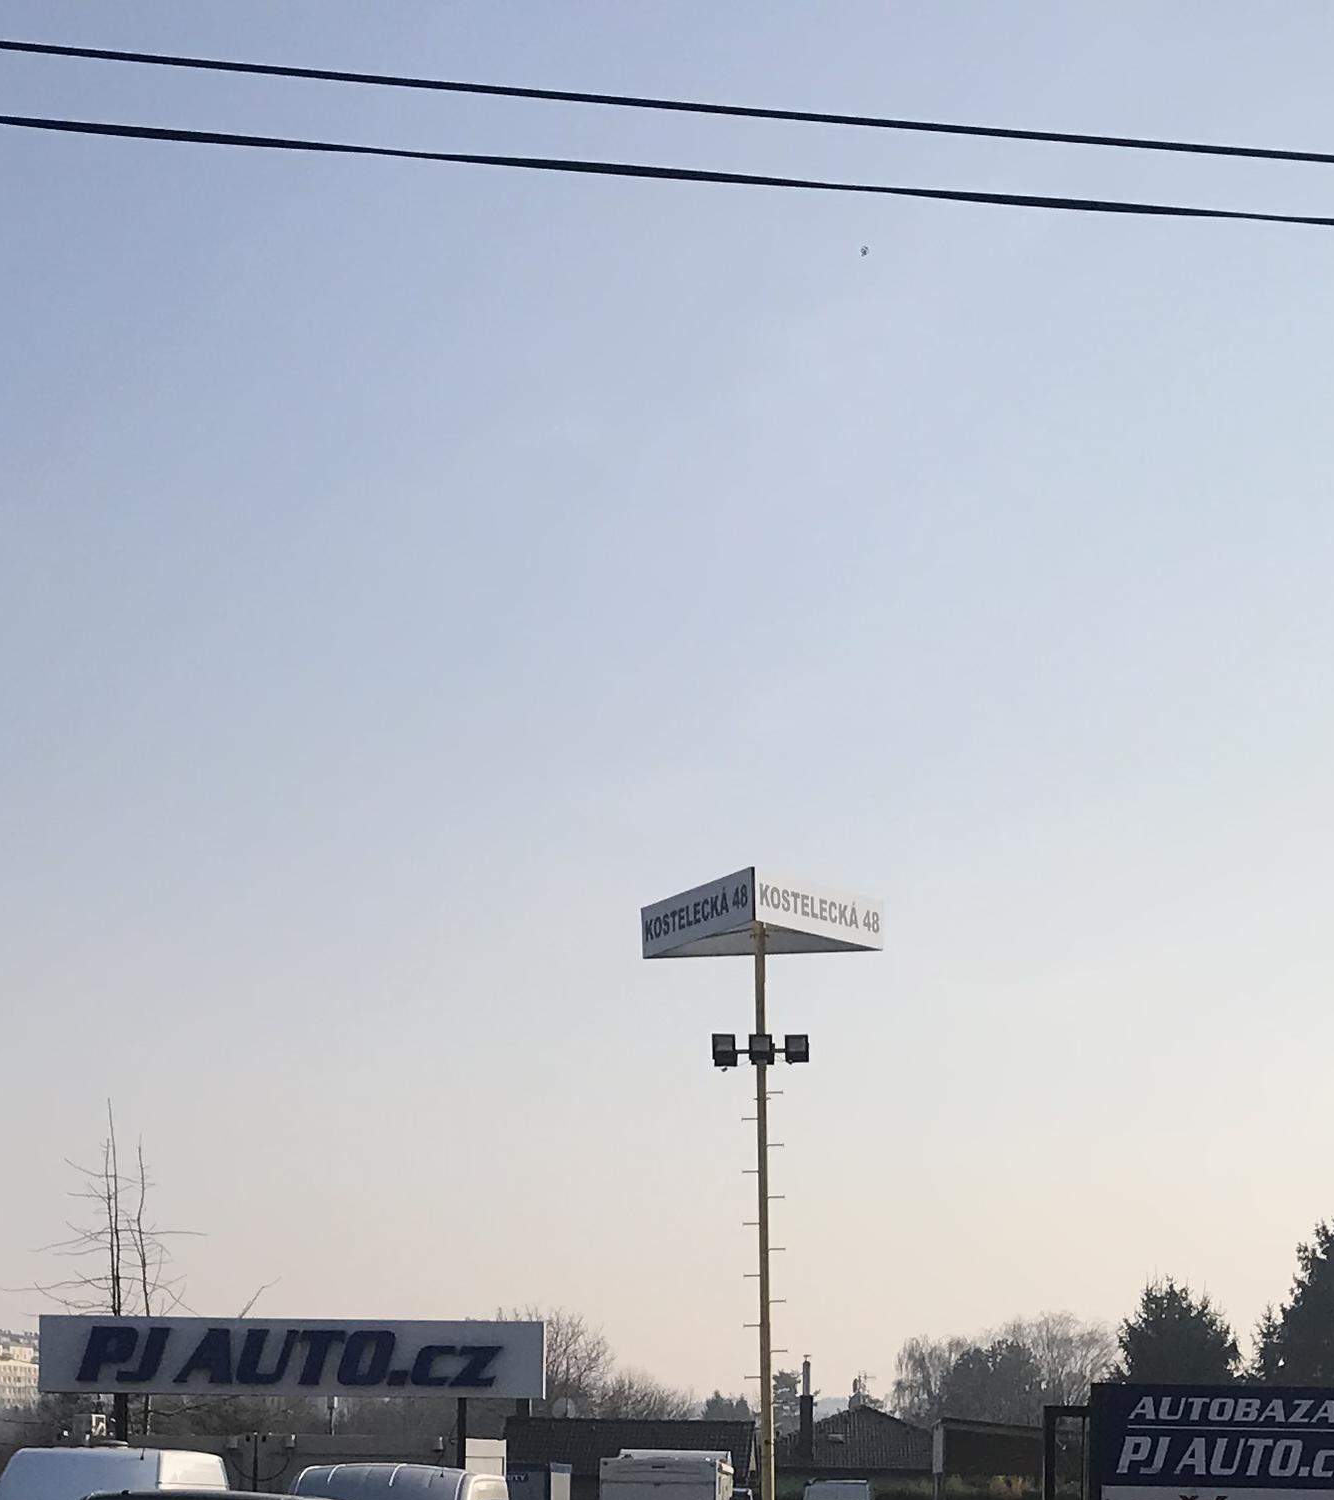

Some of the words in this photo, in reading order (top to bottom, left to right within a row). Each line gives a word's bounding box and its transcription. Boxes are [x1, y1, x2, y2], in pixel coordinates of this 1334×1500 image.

[644, 886, 730, 942] KOSTELECKÁ
[732, 883, 749, 908] 48
[758, 882, 859, 930] KOSTELECKÁ
[862, 908, 880, 934] 48
[75, 1325, 171, 1384] PJ
[1115, 1435, 1171, 1474] PJ
